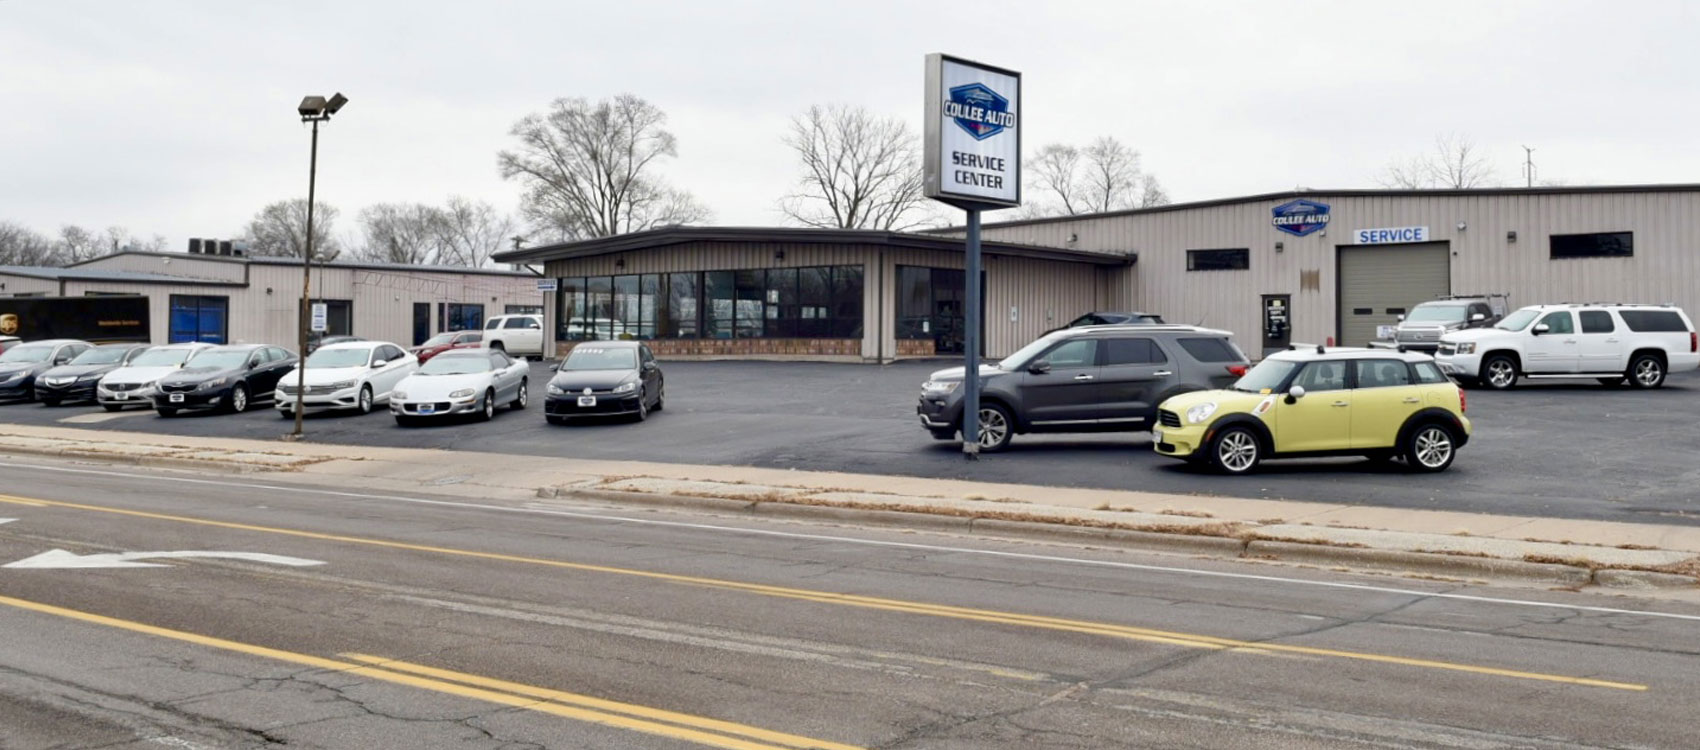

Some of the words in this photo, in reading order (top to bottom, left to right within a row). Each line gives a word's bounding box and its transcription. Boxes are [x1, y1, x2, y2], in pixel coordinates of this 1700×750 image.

[944, 102, 984, 123] COULEE
[984, 109, 1014, 127] AUTO
[952, 151, 1005, 172] SERVICE
[955, 170, 1003, 189] CENTER
[1272, 215, 1304, 225] COULEE
[1304, 214, 1330, 224] AUTO
[1360, 228, 1422, 243] SERVICE
